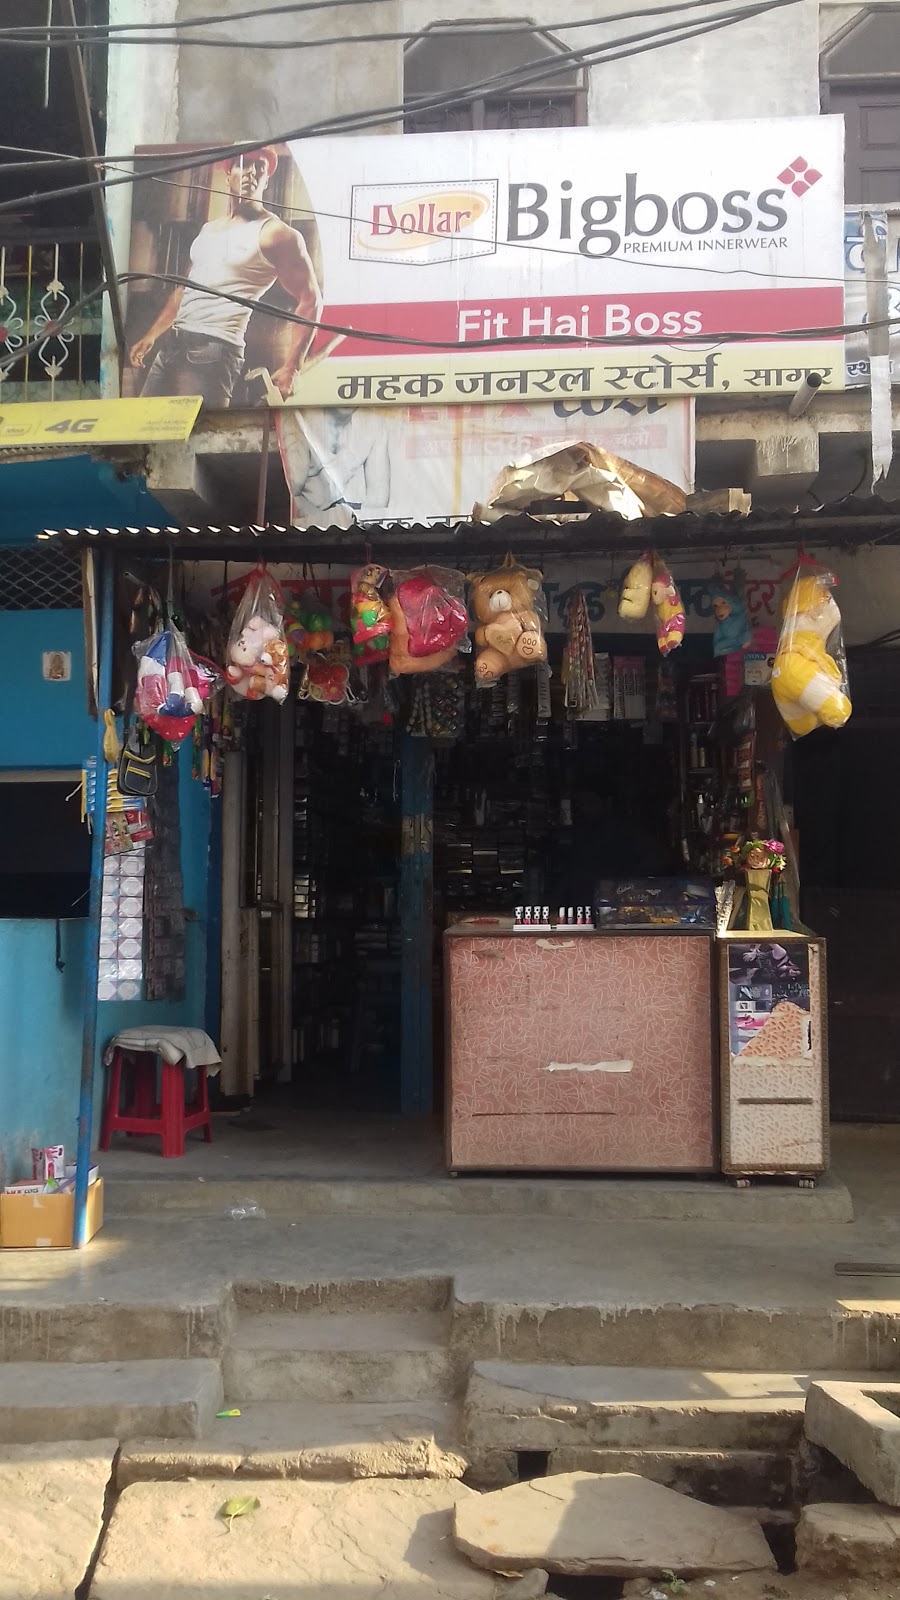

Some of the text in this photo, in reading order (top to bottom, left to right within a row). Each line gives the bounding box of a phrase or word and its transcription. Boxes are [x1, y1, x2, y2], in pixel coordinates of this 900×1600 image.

[371, 203, 472, 236] Dollar
[507, 173, 788, 259] Bigboss
[623, 237, 788, 253] PREMIUM INNERWEAR
[458, 303, 703, 342] Fit Hai Boss
[337, 373, 446, 401] महक
[454, 367, 595, 396] जनरल
[44, 418, 98, 434] 4G
